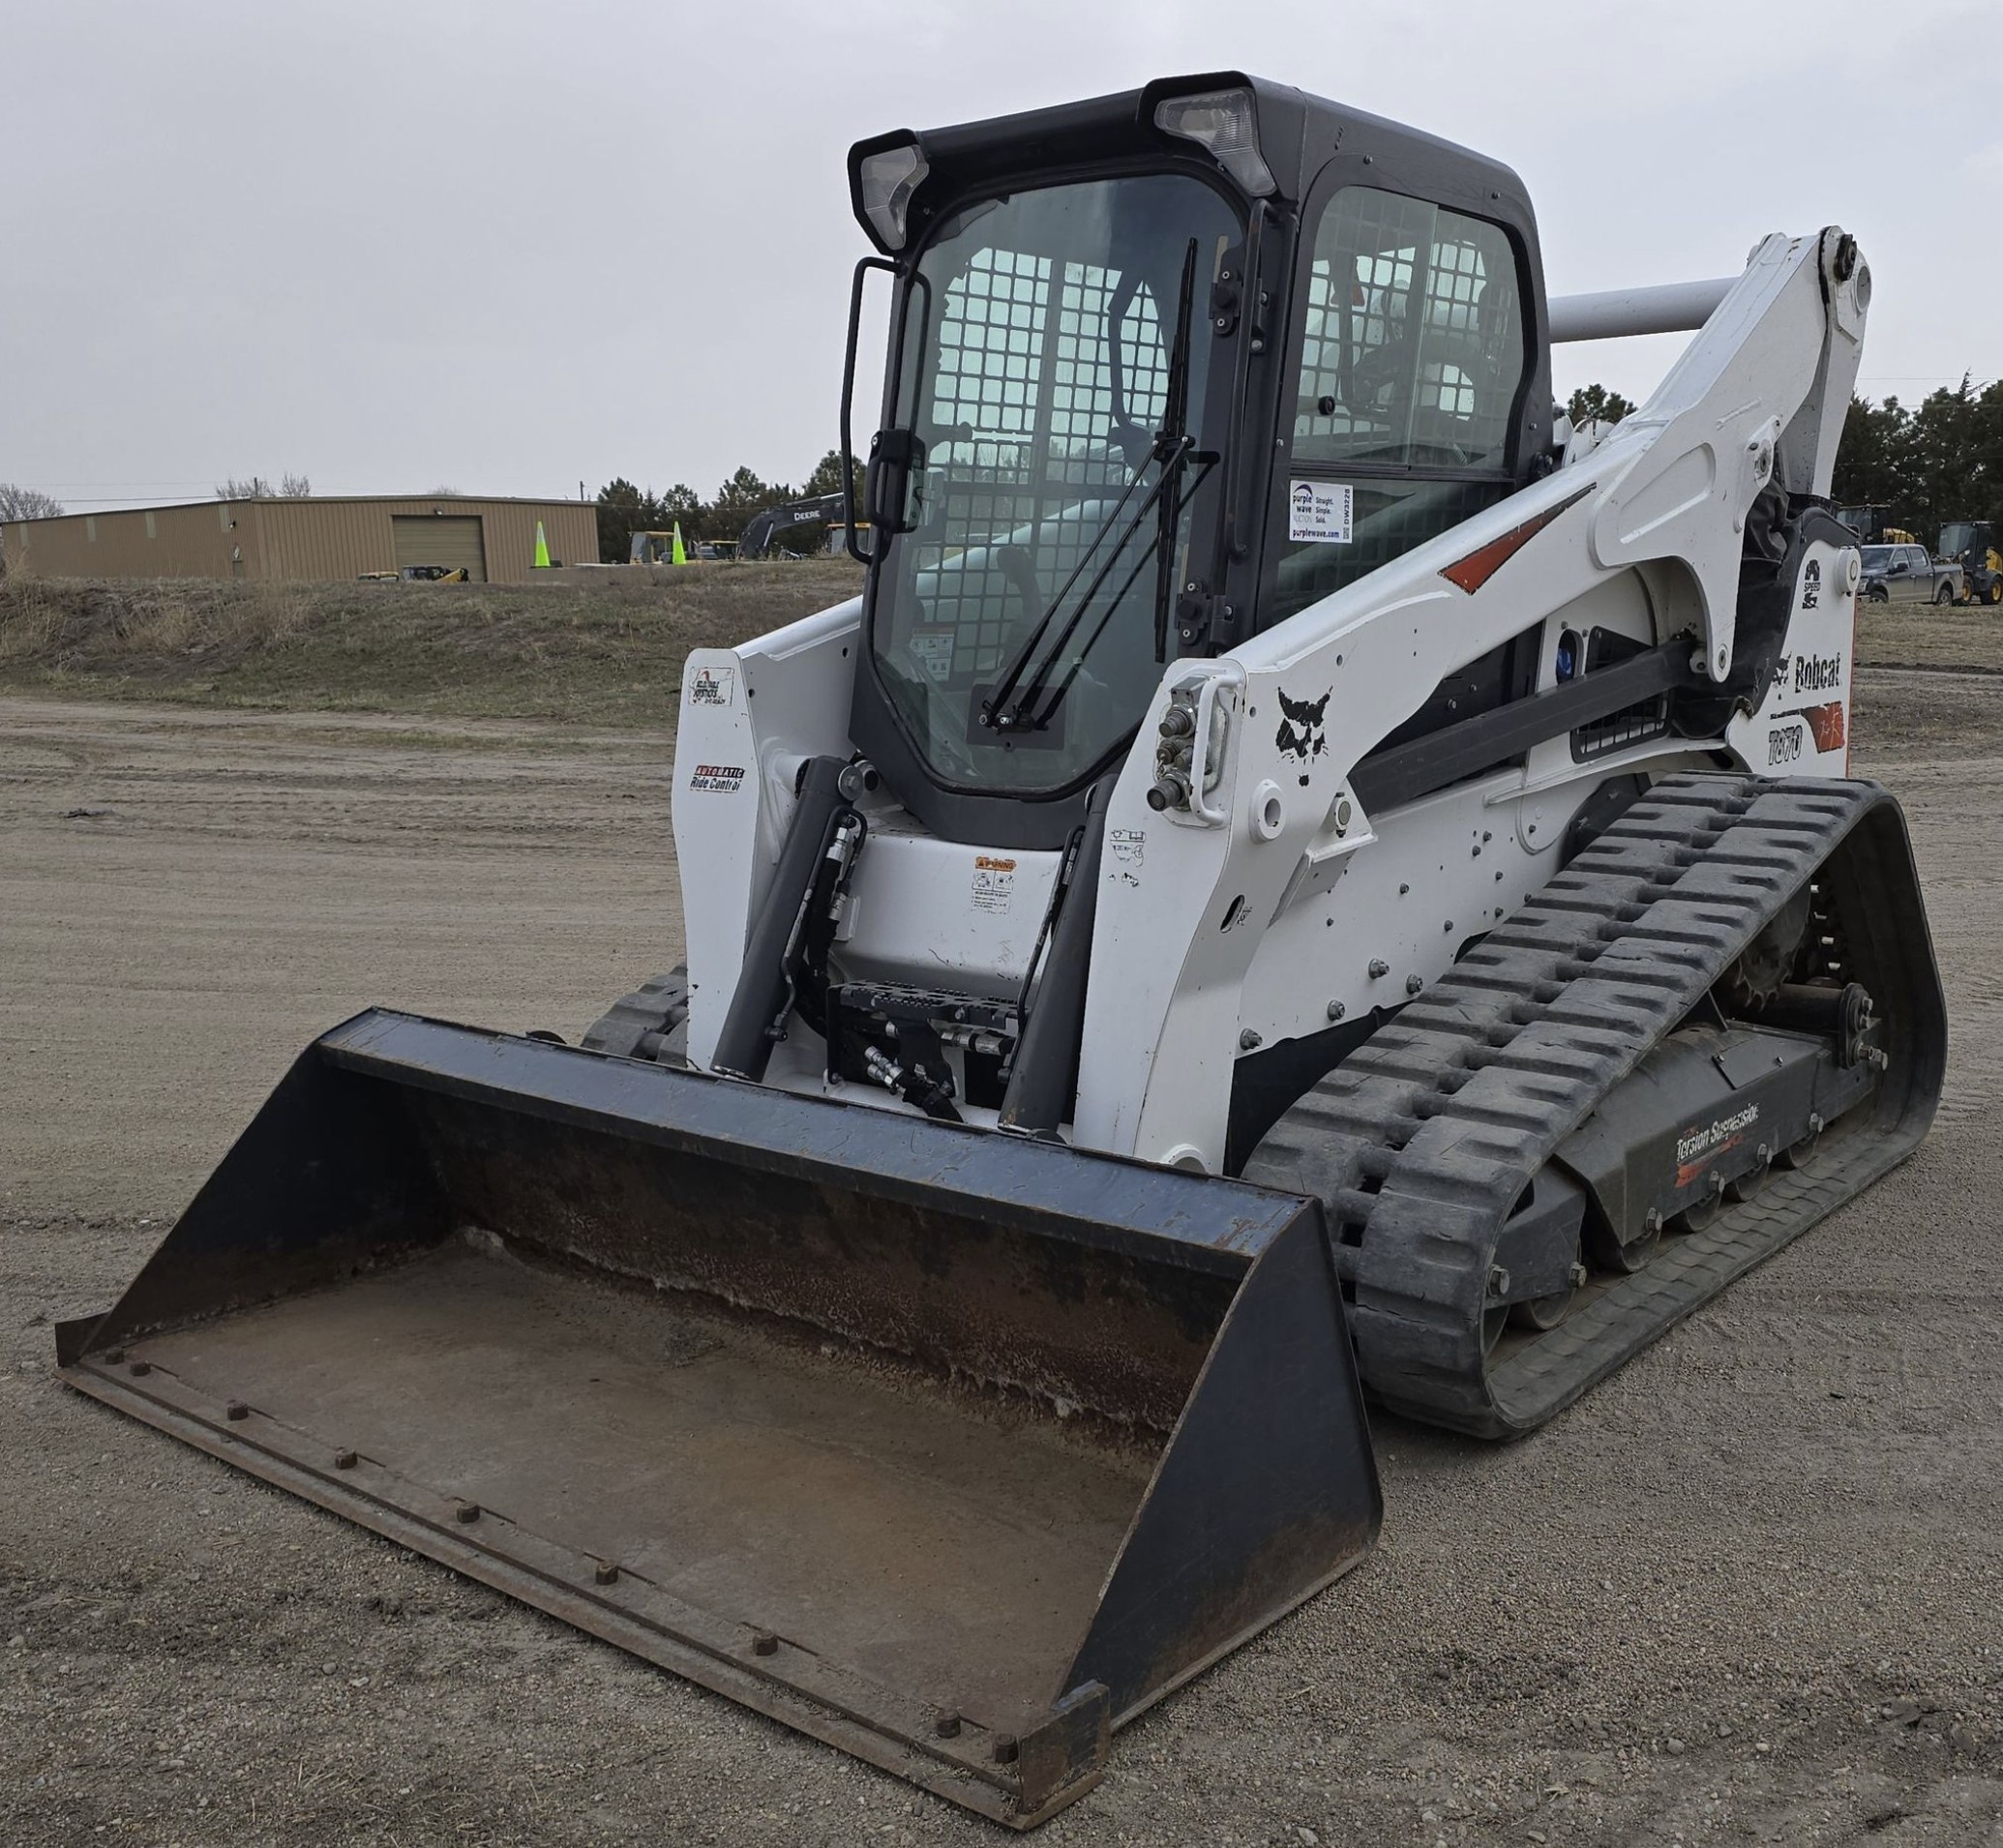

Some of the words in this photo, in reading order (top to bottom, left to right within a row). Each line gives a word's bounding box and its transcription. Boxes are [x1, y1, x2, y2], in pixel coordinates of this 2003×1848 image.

[1293, 493, 1312, 504] purple
[1297, 505, 1312, 514] wave
[793, 510, 821, 522] DEERE
[1293, 527, 1339, 539] purplewave.com
[1804, 581, 1820, 592] SPEED
[1795, 652, 1840, 694] Bobcat
[1768, 725, 1803, 766] T870
[695, 765, 744, 778] AUTOMATIC
[690, 776, 709, 789] Ride
[709, 778, 741, 790] Control
[1677, 1128, 1711, 1161] Torsion
